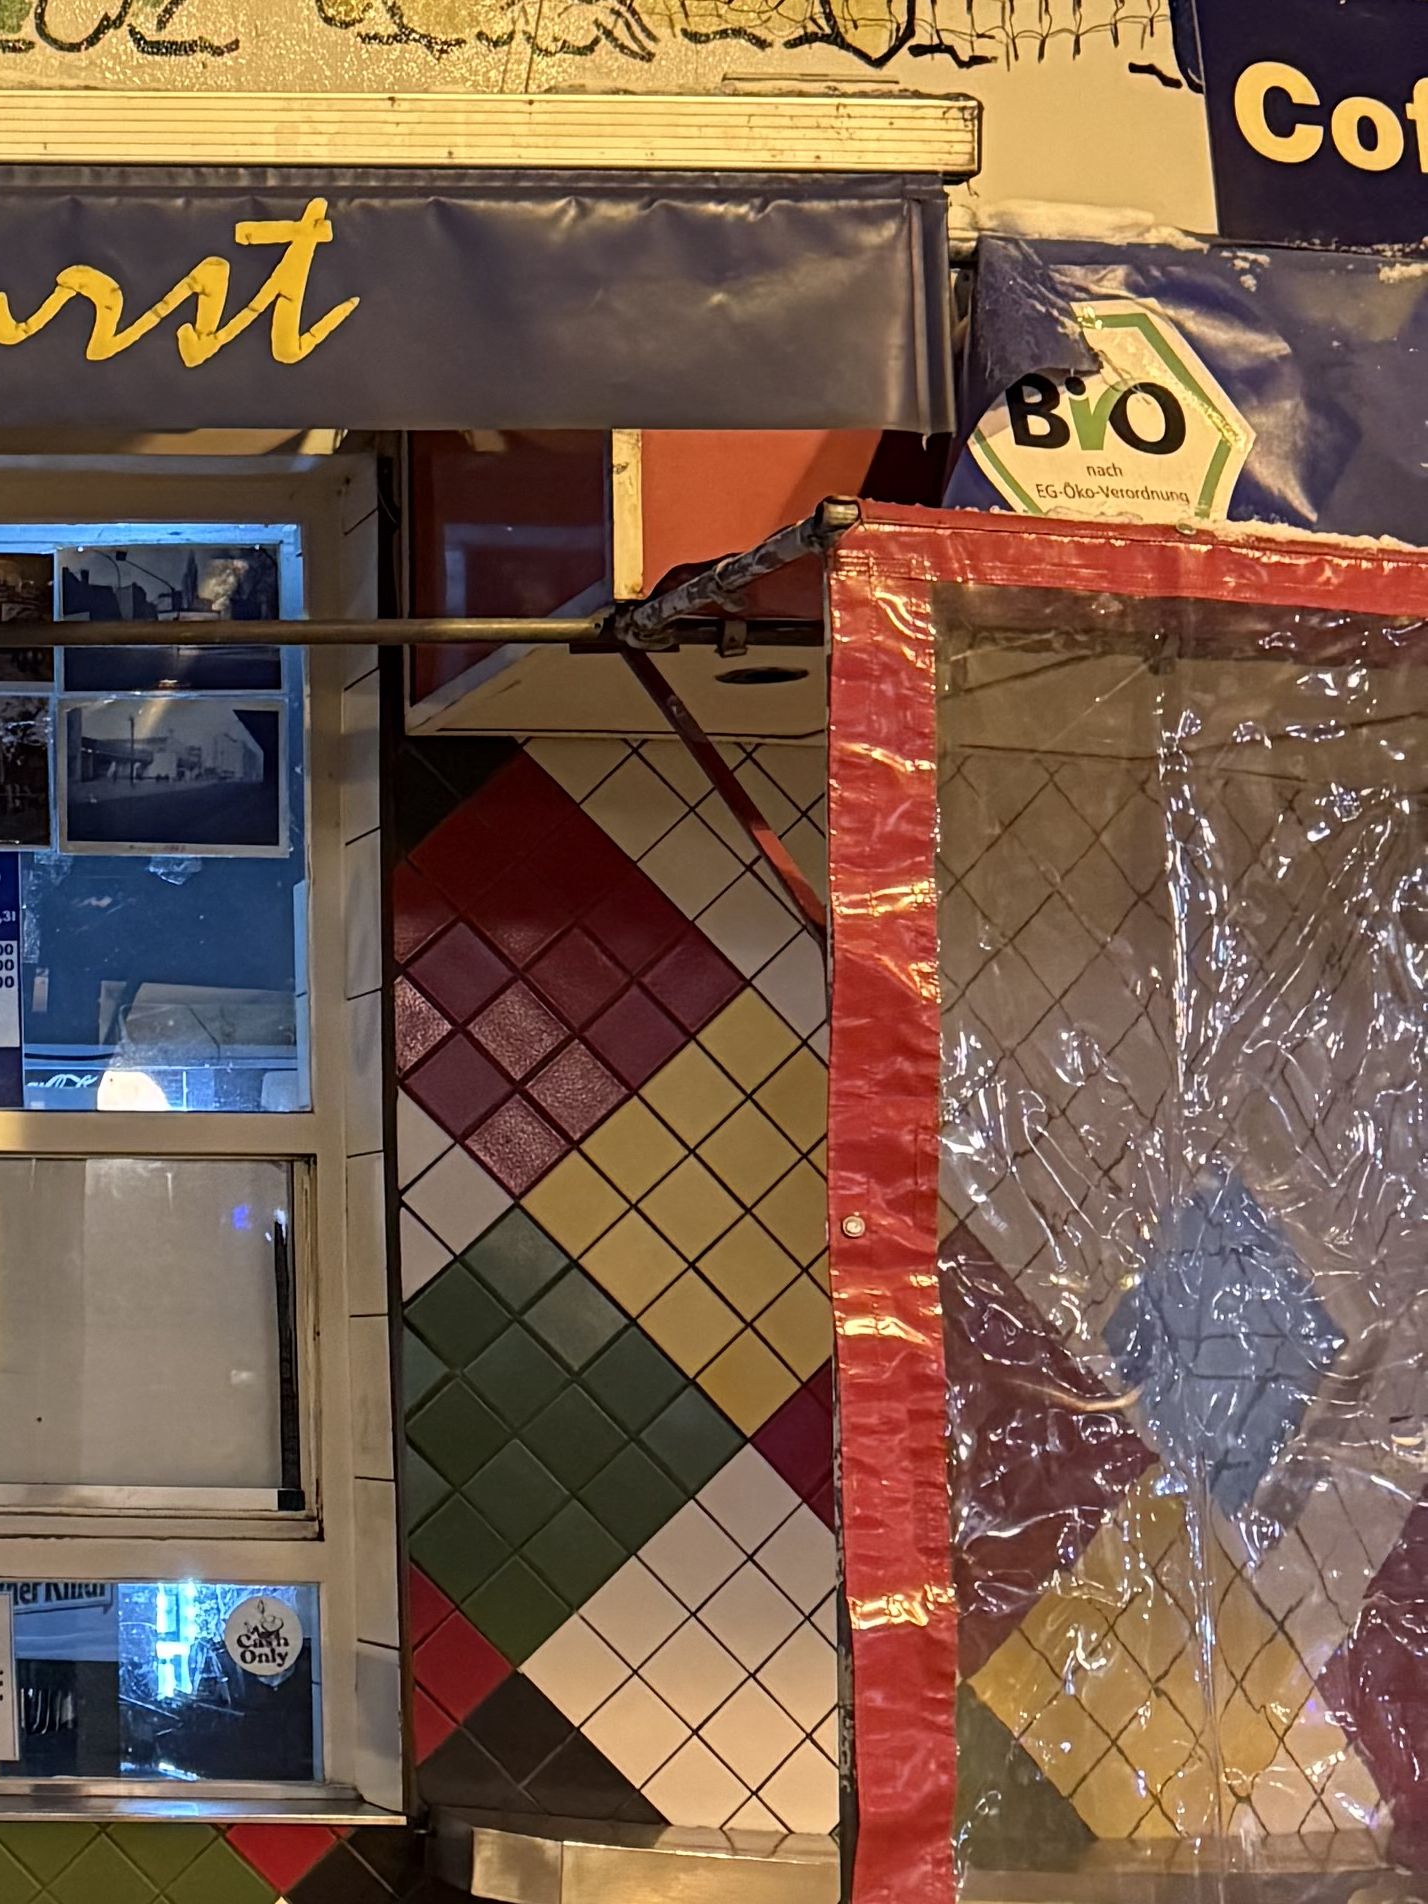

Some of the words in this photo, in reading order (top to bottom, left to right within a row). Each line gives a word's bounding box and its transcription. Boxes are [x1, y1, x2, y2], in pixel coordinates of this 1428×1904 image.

[1086, 462, 1123, 480] nach
[1035, 480, 1191, 507] EG-Öko-Verordnung
[240, 1647, 289, 1668] Only
